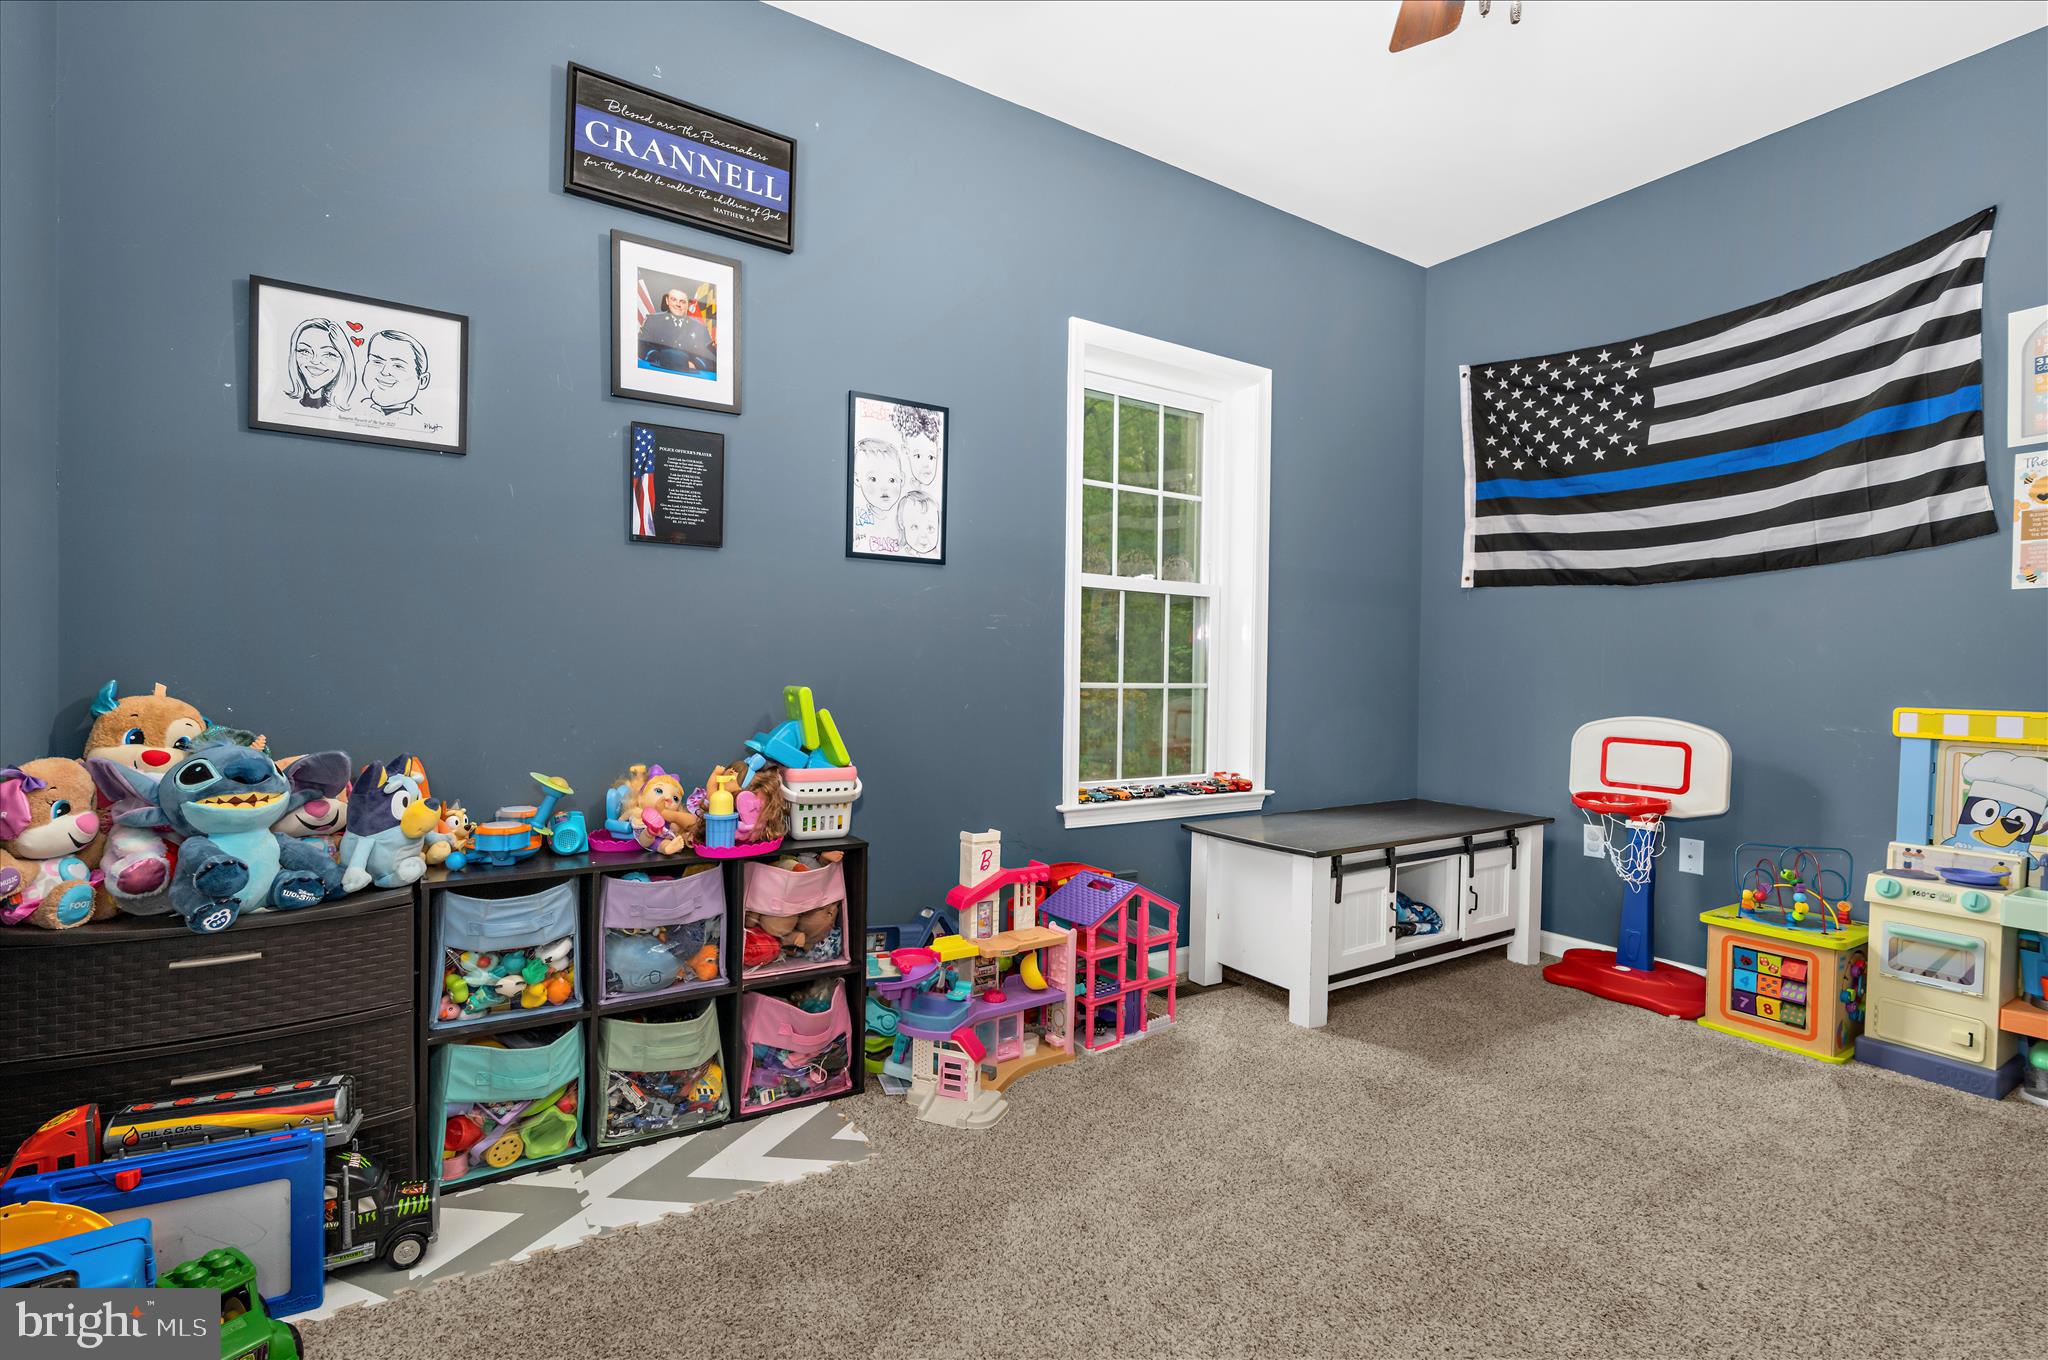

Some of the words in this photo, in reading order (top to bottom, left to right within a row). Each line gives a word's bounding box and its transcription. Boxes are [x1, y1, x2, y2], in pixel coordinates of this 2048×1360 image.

[604, 98, 655, 124] Blessed
[656, 120, 677, 131] are
[700, 130, 768, 161] Peacemakers
[585, 120, 782, 201] CRANNELL
[583, 156, 600, 167] for
[627, 168, 653, 183] shall
[655, 175, 666, 186] be
[666, 183, 694, 195] called
[713, 194, 750, 212] children
[750, 207, 762, 217] of
[761, 208, 781, 221] God
[713, 206, 745, 220] MATTHEW
[980, 849, 993, 871] B
[0, 874, 19, 886] MUSIC
[69, 901, 91, 910] FOOT
[1739, 975, 1749, 987] 4
[1739, 996, 1750, 1008] 7
[1763, 1003, 1774, 1015] 8
[140, 1130, 161, 1139] OIL
[163, 1127, 173, 1136] &
[174, 1123, 202, 1134] GAS
